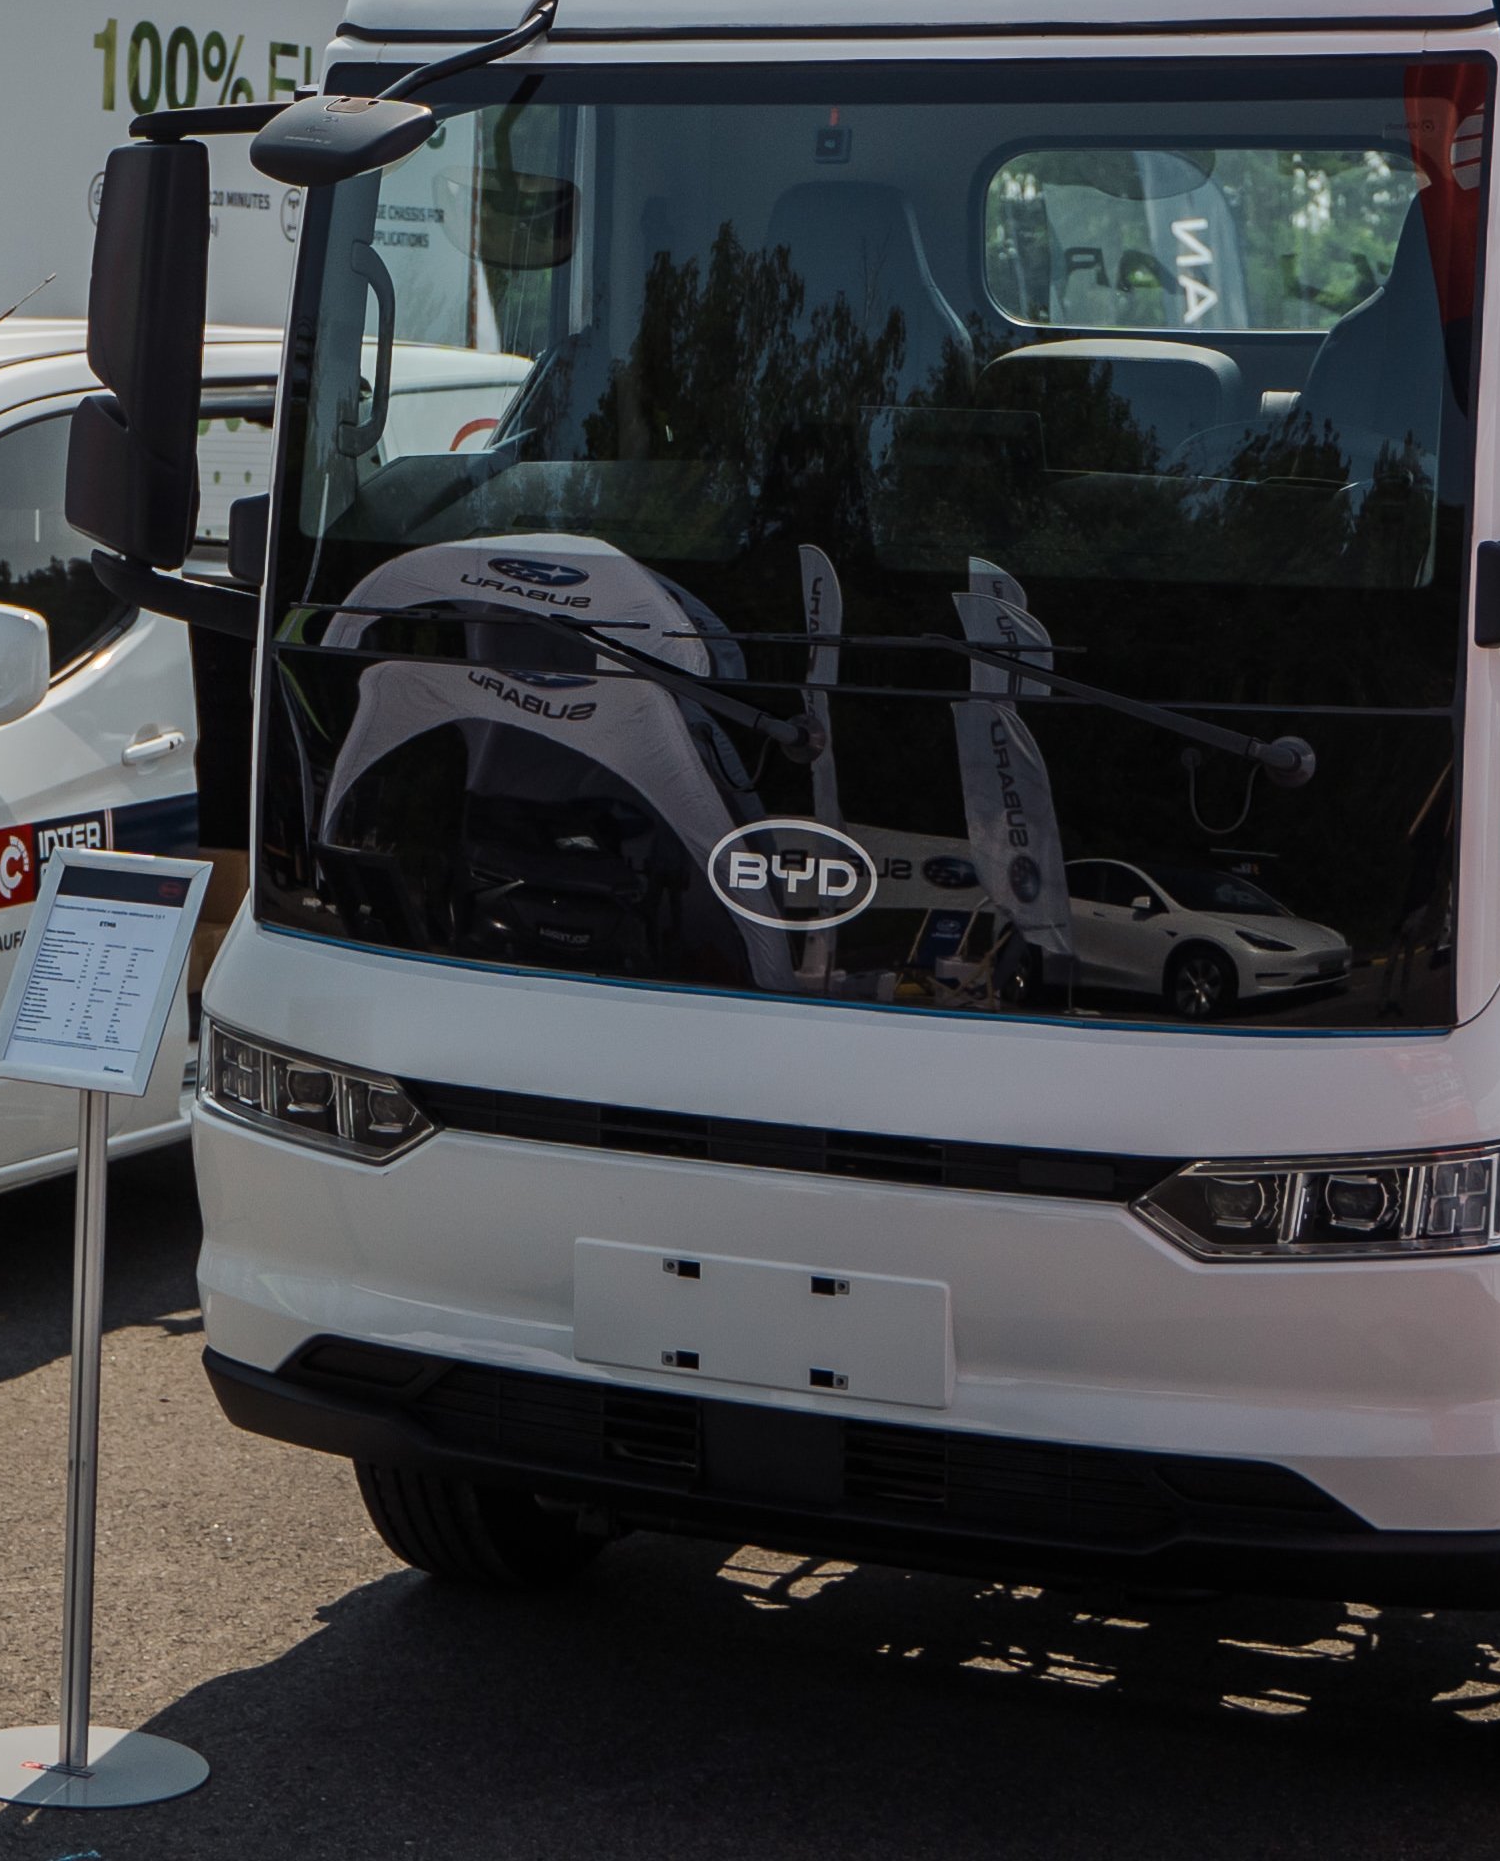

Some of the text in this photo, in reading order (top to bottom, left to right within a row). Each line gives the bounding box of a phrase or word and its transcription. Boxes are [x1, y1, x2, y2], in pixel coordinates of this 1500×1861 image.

[93, 18, 255, 116] 100%
[226, 191, 270, 210] MINUTES
[37, 821, 101, 859] INTER
[728, 851, 858, 897] BYD
